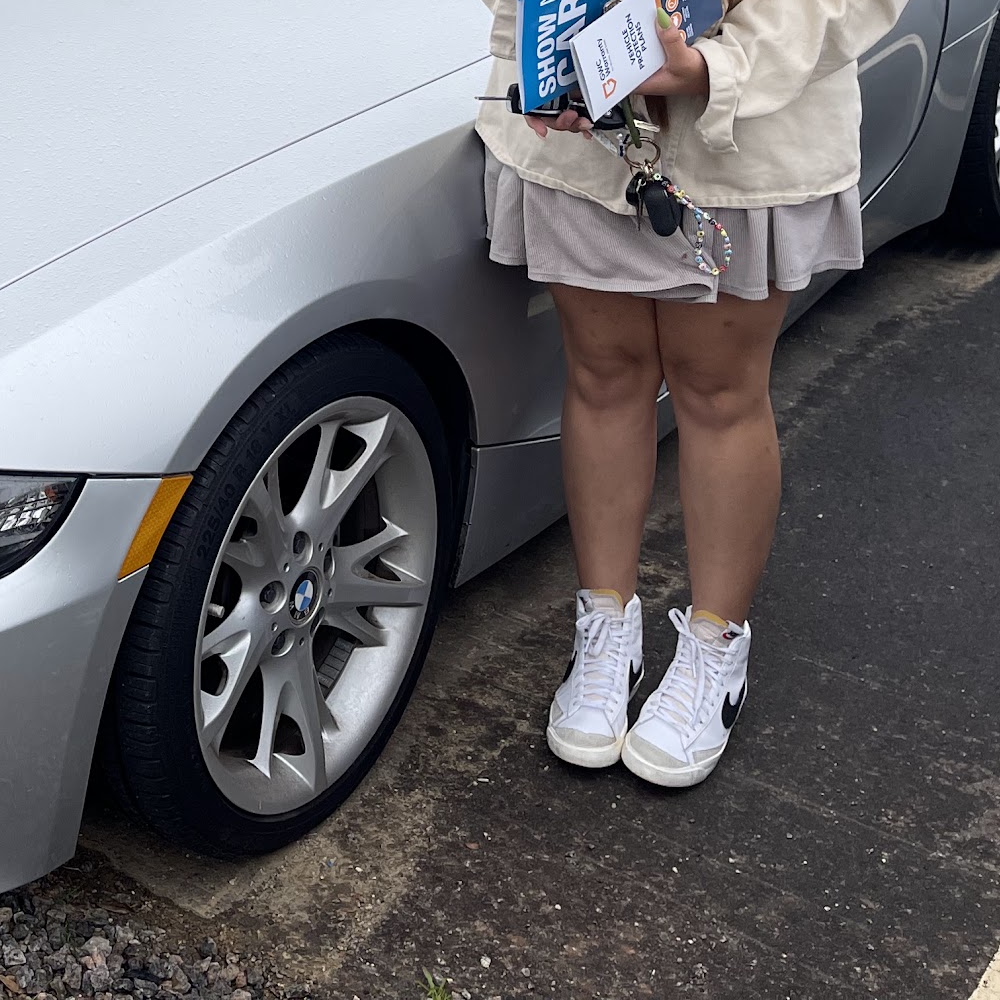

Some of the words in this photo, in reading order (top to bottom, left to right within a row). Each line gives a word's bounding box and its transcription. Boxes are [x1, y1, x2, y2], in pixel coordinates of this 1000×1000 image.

[537, 13, 557, 98] SHOW
[621, 28, 636, 65] VEHICLE
[625, 13, 645, 70] PROTECTION
[635, 21, 647, 53] PLANS
[596, 59, 606, 81] GWC
[597, 38, 611, 77] Warranty
